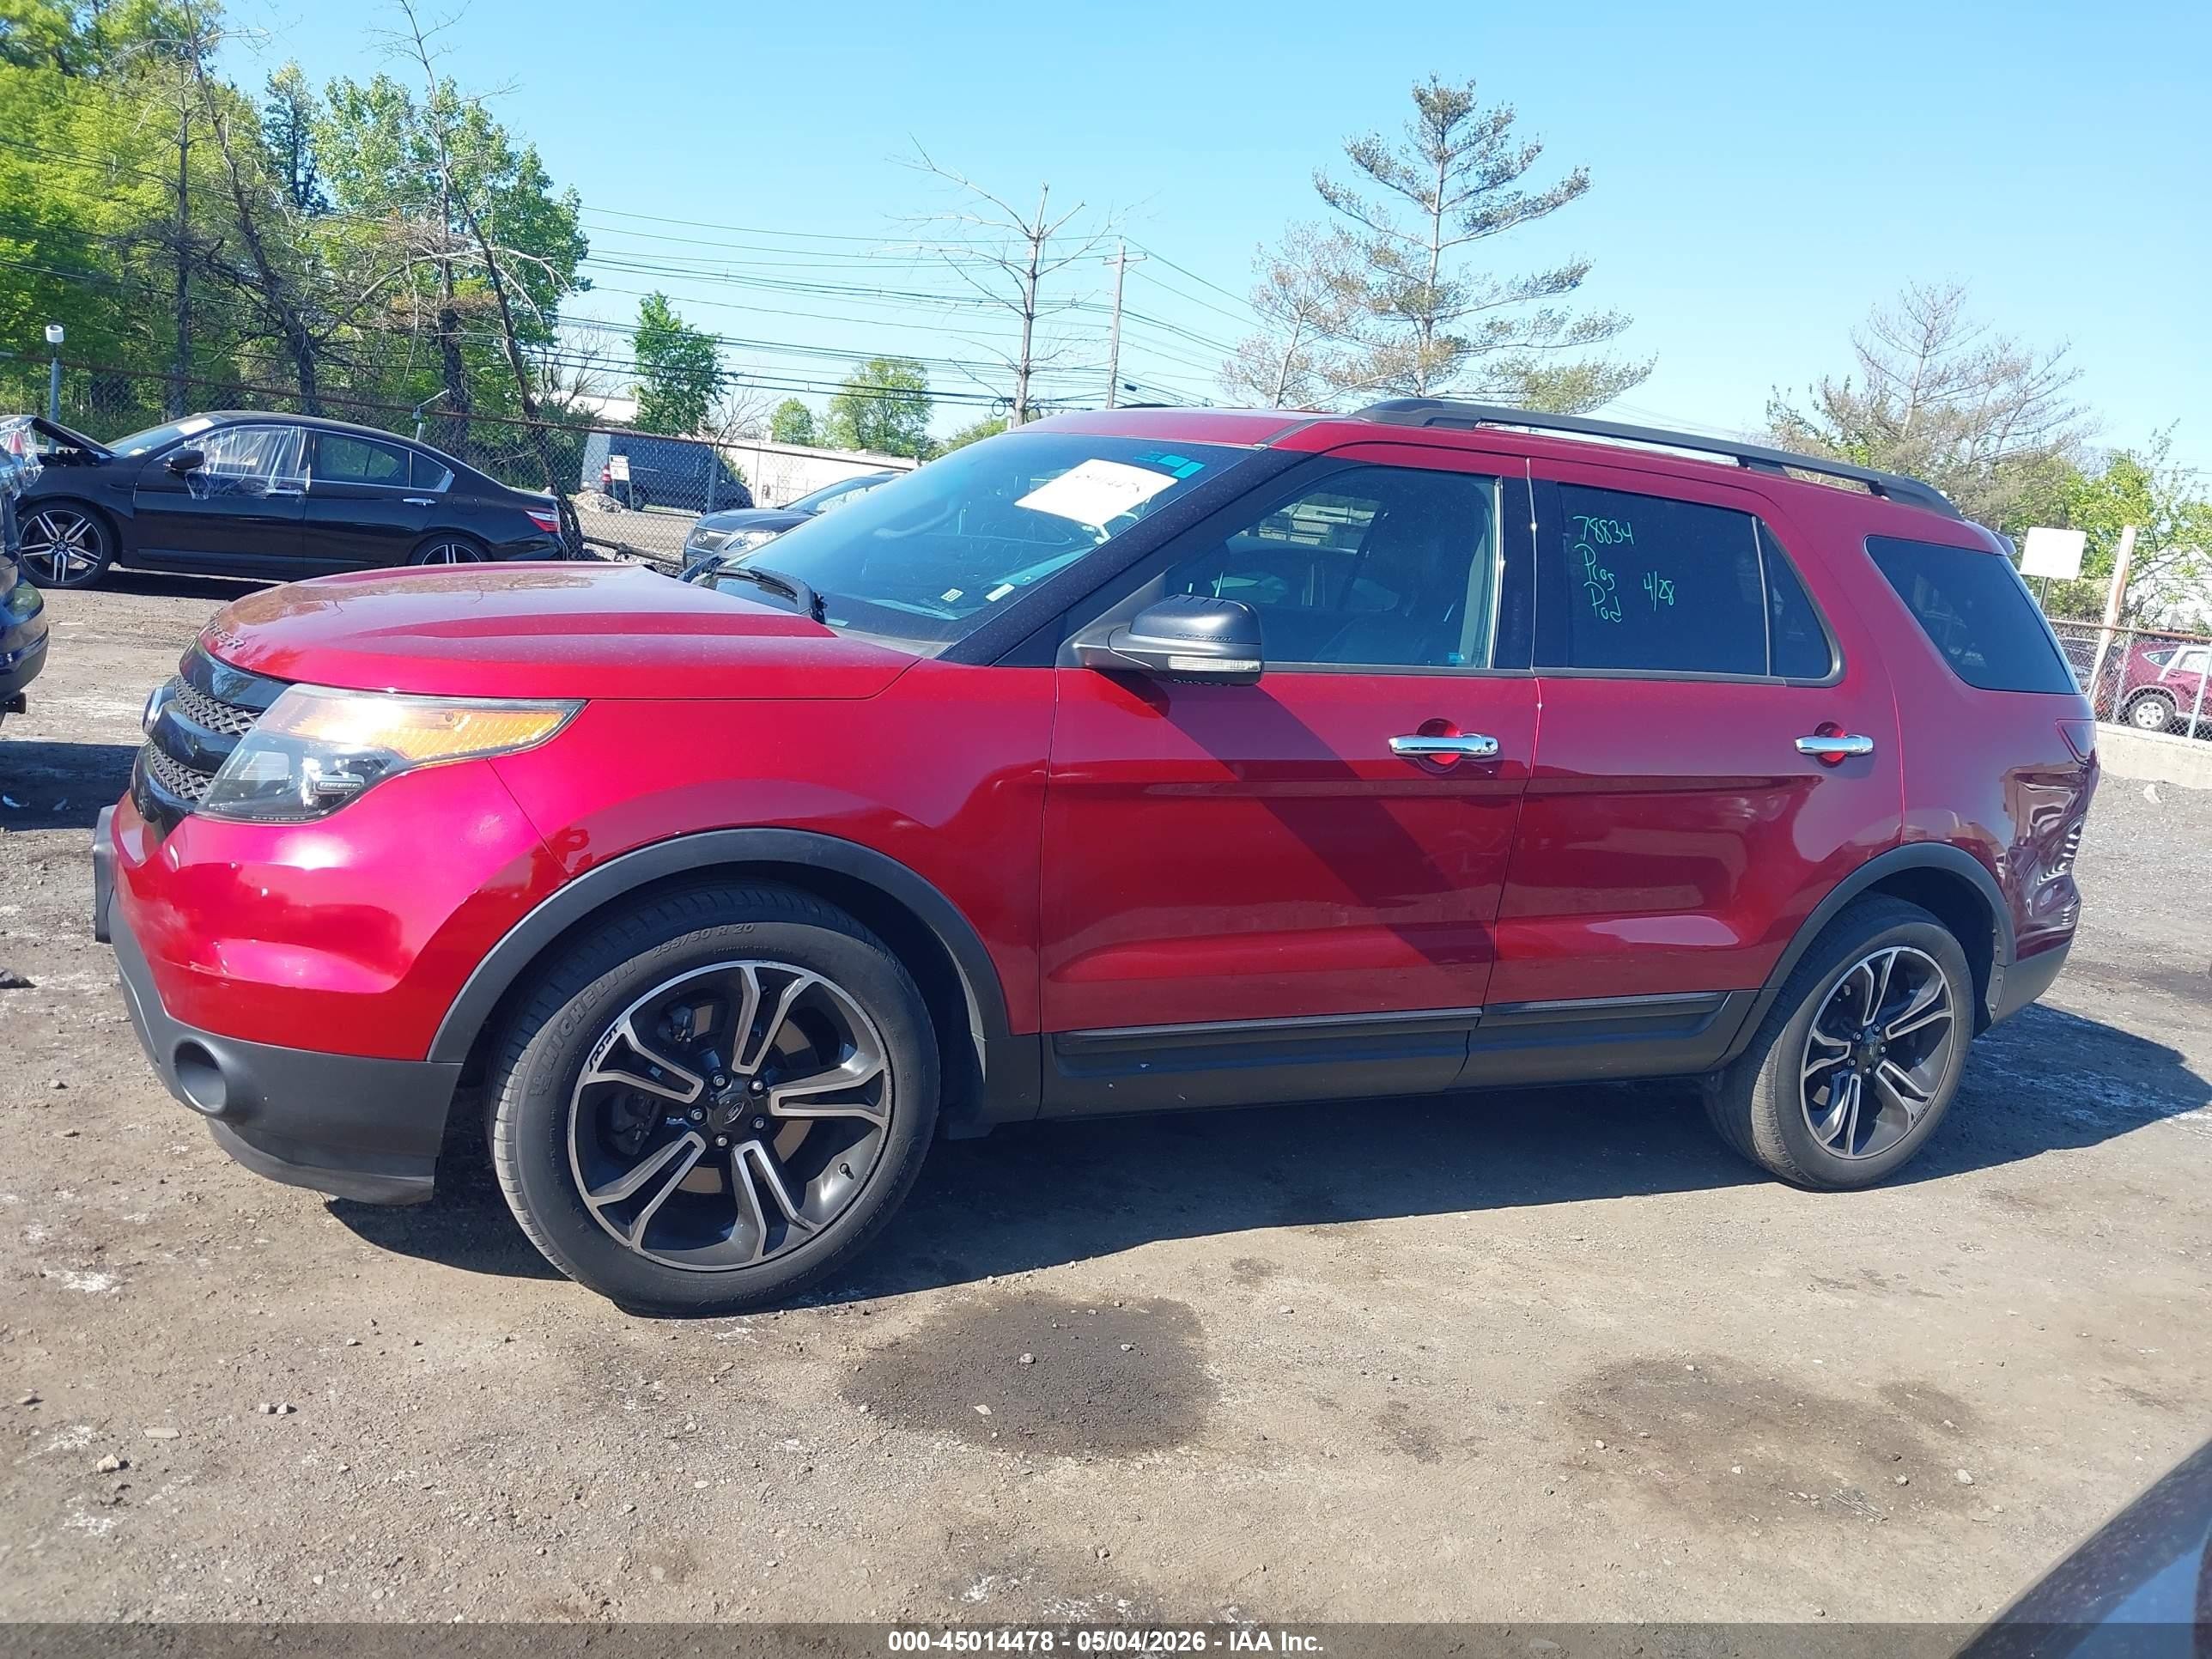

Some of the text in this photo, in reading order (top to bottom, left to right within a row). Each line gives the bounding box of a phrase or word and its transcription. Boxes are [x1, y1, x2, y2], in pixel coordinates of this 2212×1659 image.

[1572, 515, 1634, 545] 78834
[1643, 570, 1675, 611] 4/28
[653, 927, 711, 958] 255/50
[716, 925, 728, 937] R
[732, 922, 755, 935] 20
[540, 956, 638, 1071] MICHELIN
[588, 1022, 619, 1073] SPORT
